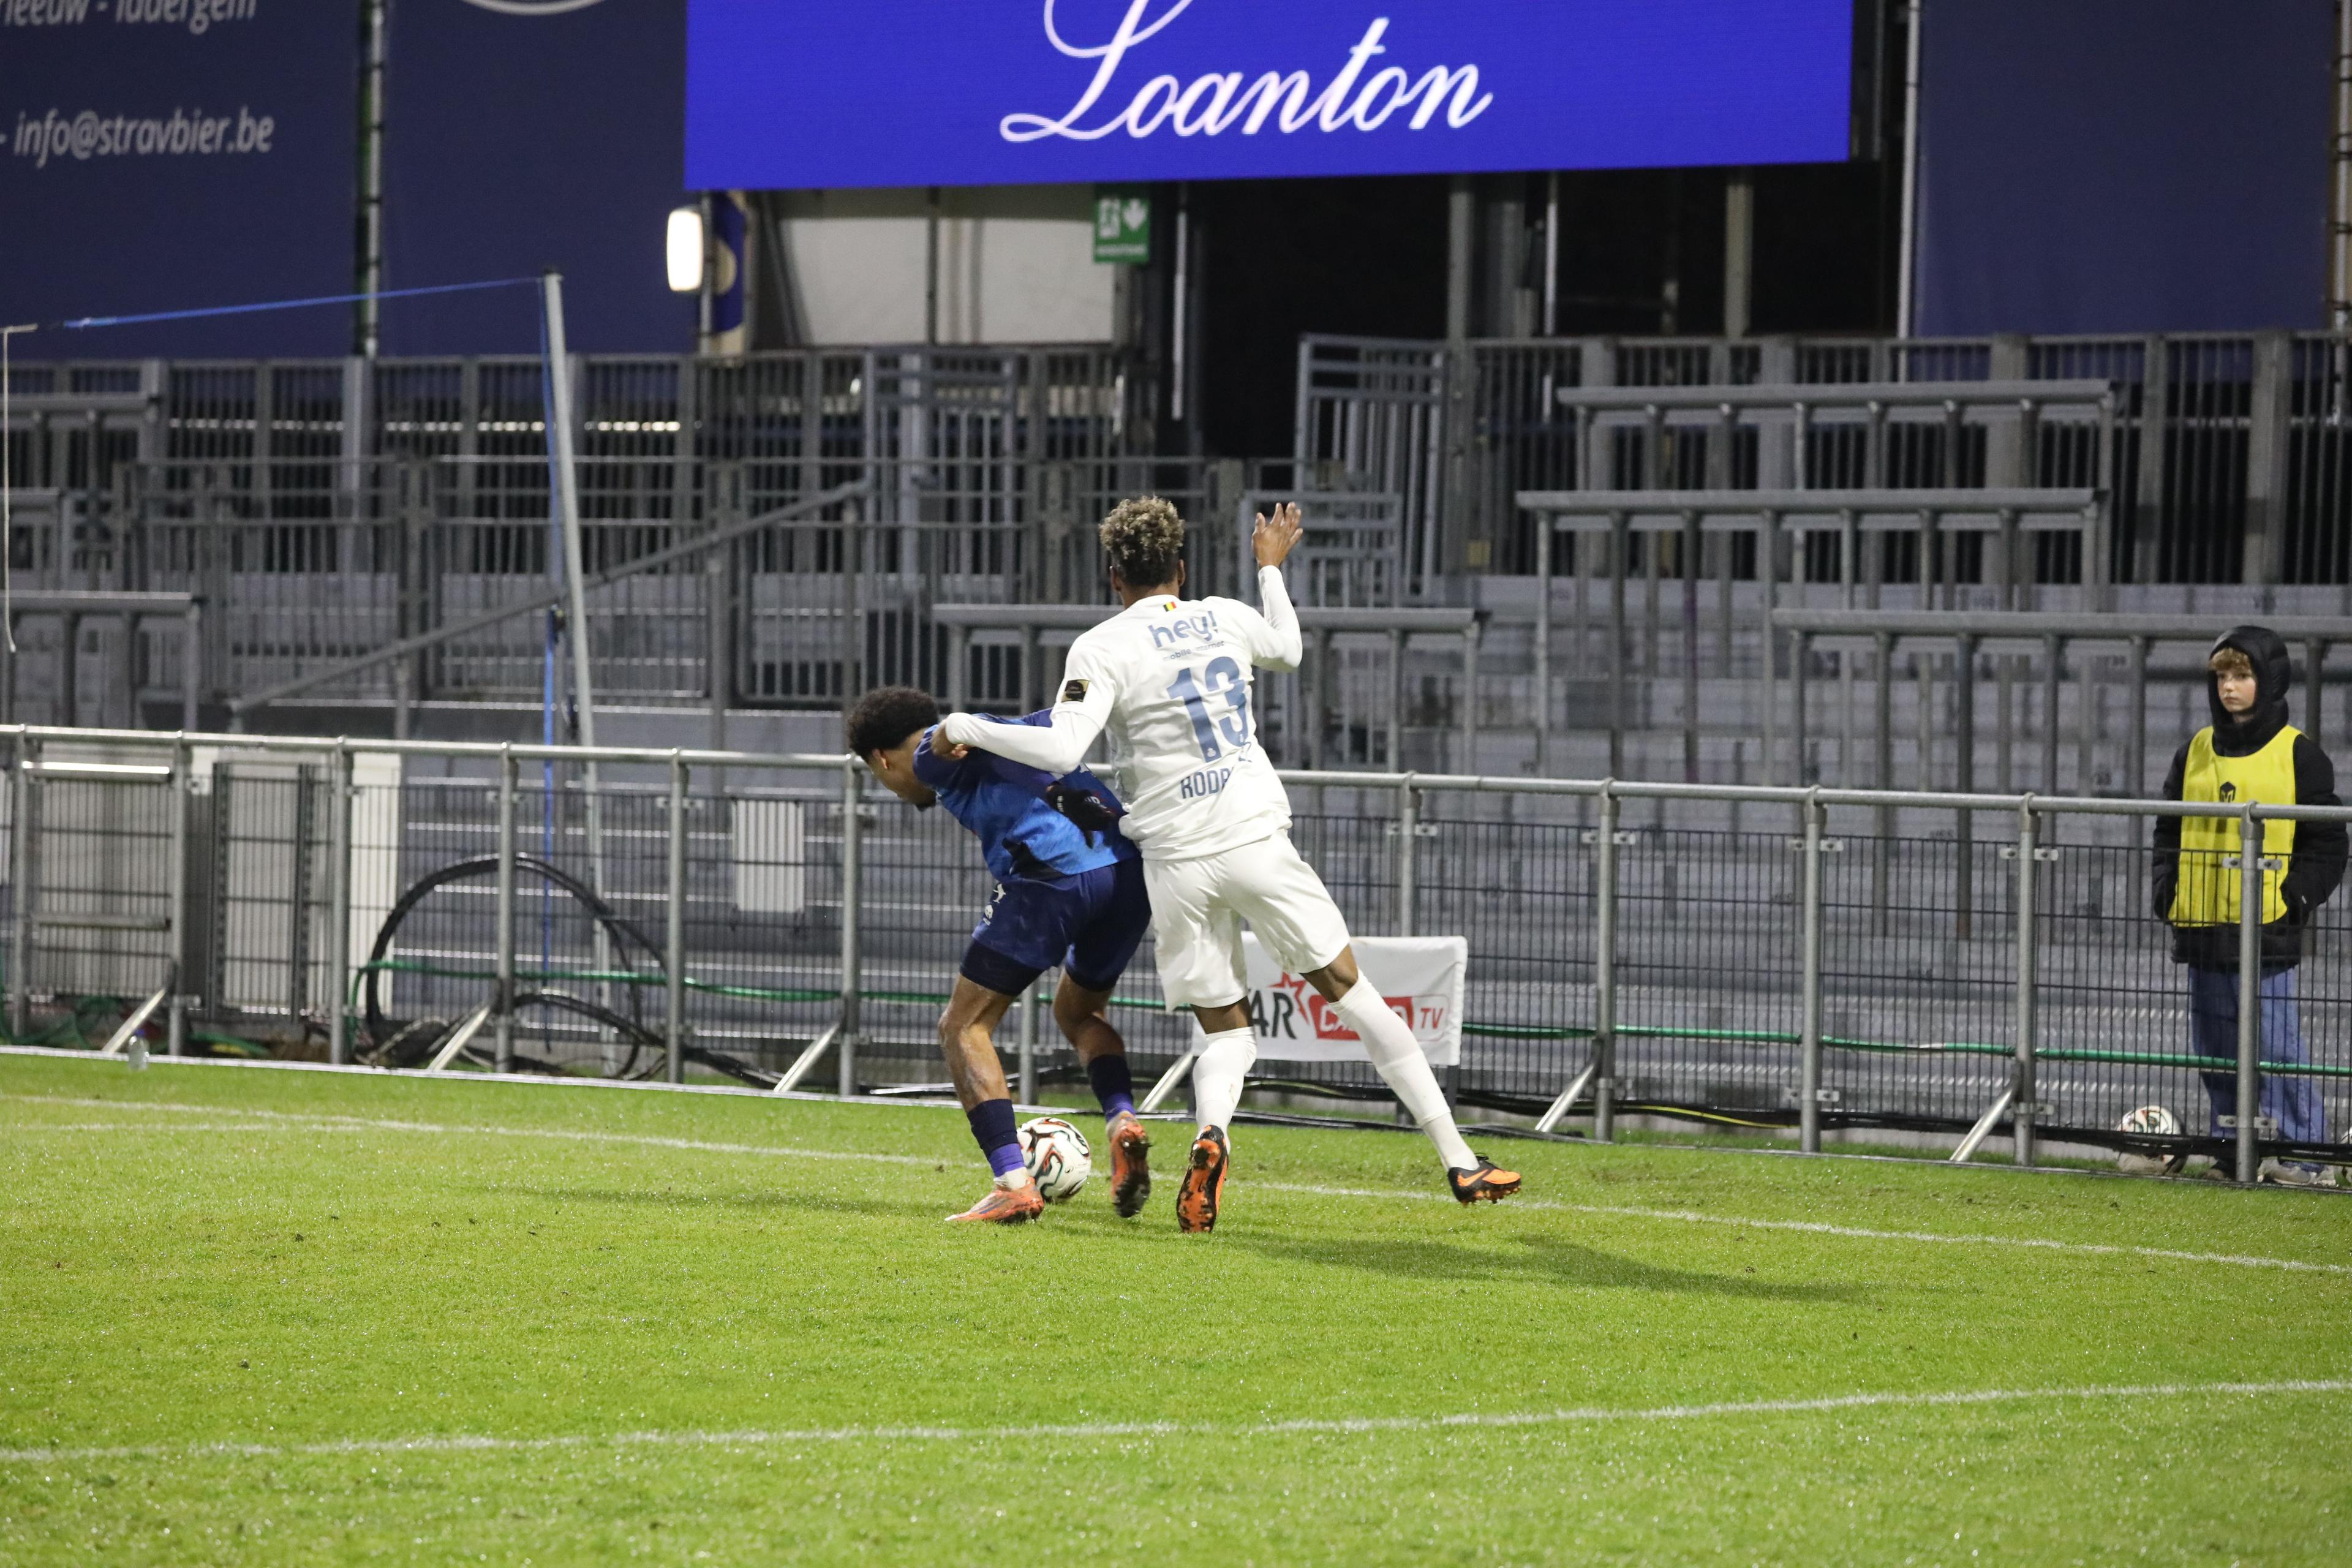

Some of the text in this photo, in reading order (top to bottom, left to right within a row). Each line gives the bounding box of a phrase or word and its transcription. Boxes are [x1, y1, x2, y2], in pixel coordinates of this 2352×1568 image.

[1000, 0, 1494, 141] Loanton
[13, 105, 275, 168] info@stravbier.be
[1148, 610, 1219, 648] hey!
[1166, 656, 1249, 763] 13
[1420, 1008, 1444, 1030] TV
